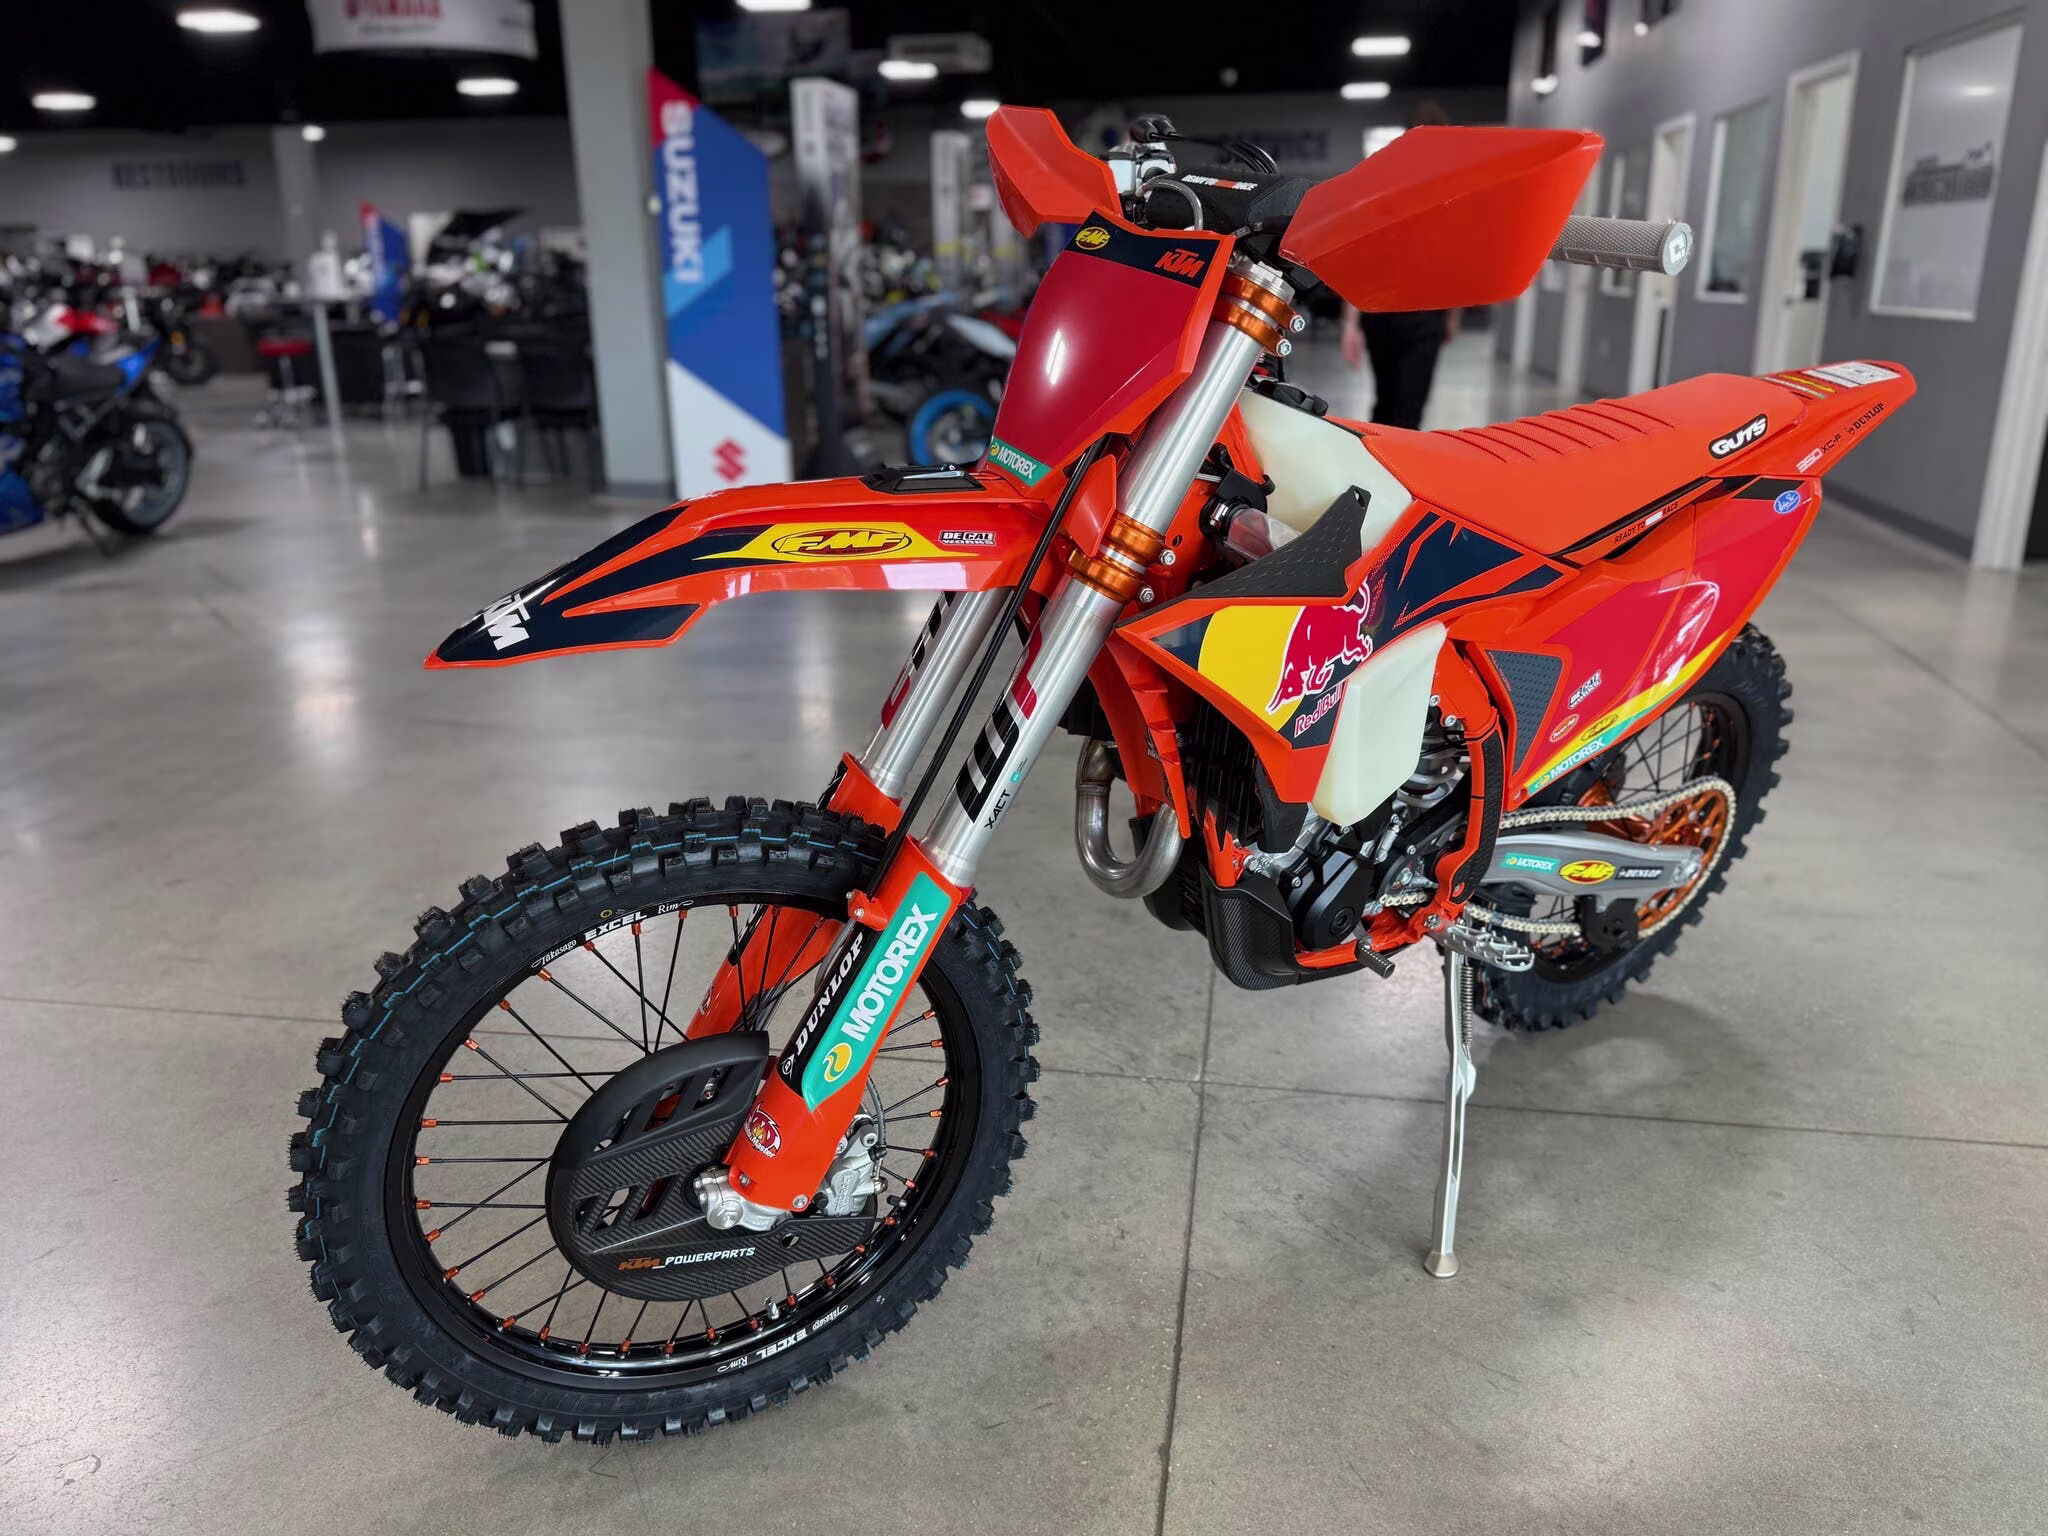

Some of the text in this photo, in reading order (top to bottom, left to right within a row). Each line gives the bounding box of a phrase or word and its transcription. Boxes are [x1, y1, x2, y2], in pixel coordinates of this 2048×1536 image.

[661, 101, 704, 283] SUZUKI
[1155, 248, 1206, 279] KTM
[1852, 402, 1885, 430] DUNLOP
[1711, 417, 1767, 455] GUTS
[997, 446, 1037, 480] MOTOREX
[777, 530, 907, 555] FMF
[484, 593, 532, 652] KTM
[1550, 736, 1606, 780] MOTOREX
[984, 789, 1011, 830] XACT
[1517, 857, 1663, 880] MOTOREX FMF DUNLOP
[584, 911, 648, 942] EXCEL
[658, 900, 690, 915] Rim
[841, 902, 939, 1043] MOTOREX
[796, 931, 864, 1057] DUNLOP
[756, 1328, 808, 1361] EXCEL
